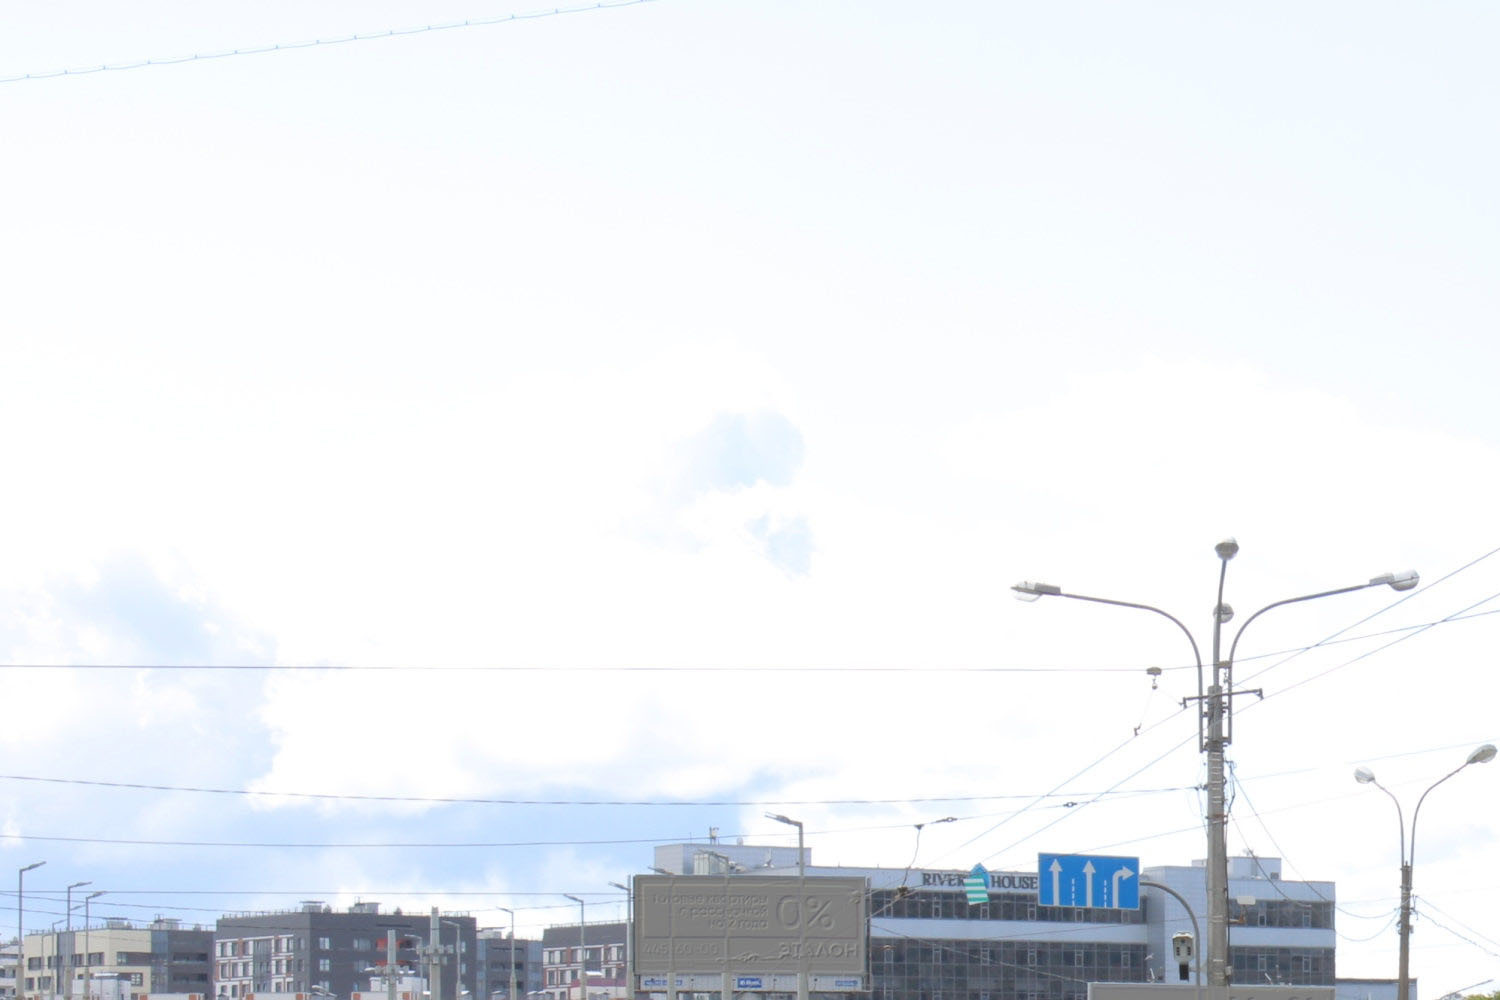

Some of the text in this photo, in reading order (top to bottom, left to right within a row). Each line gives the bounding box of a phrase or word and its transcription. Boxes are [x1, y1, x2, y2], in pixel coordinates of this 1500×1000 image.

[922, 873, 1038, 889] RIVER HOUSE
[776, 895, 834, 930] 0%
